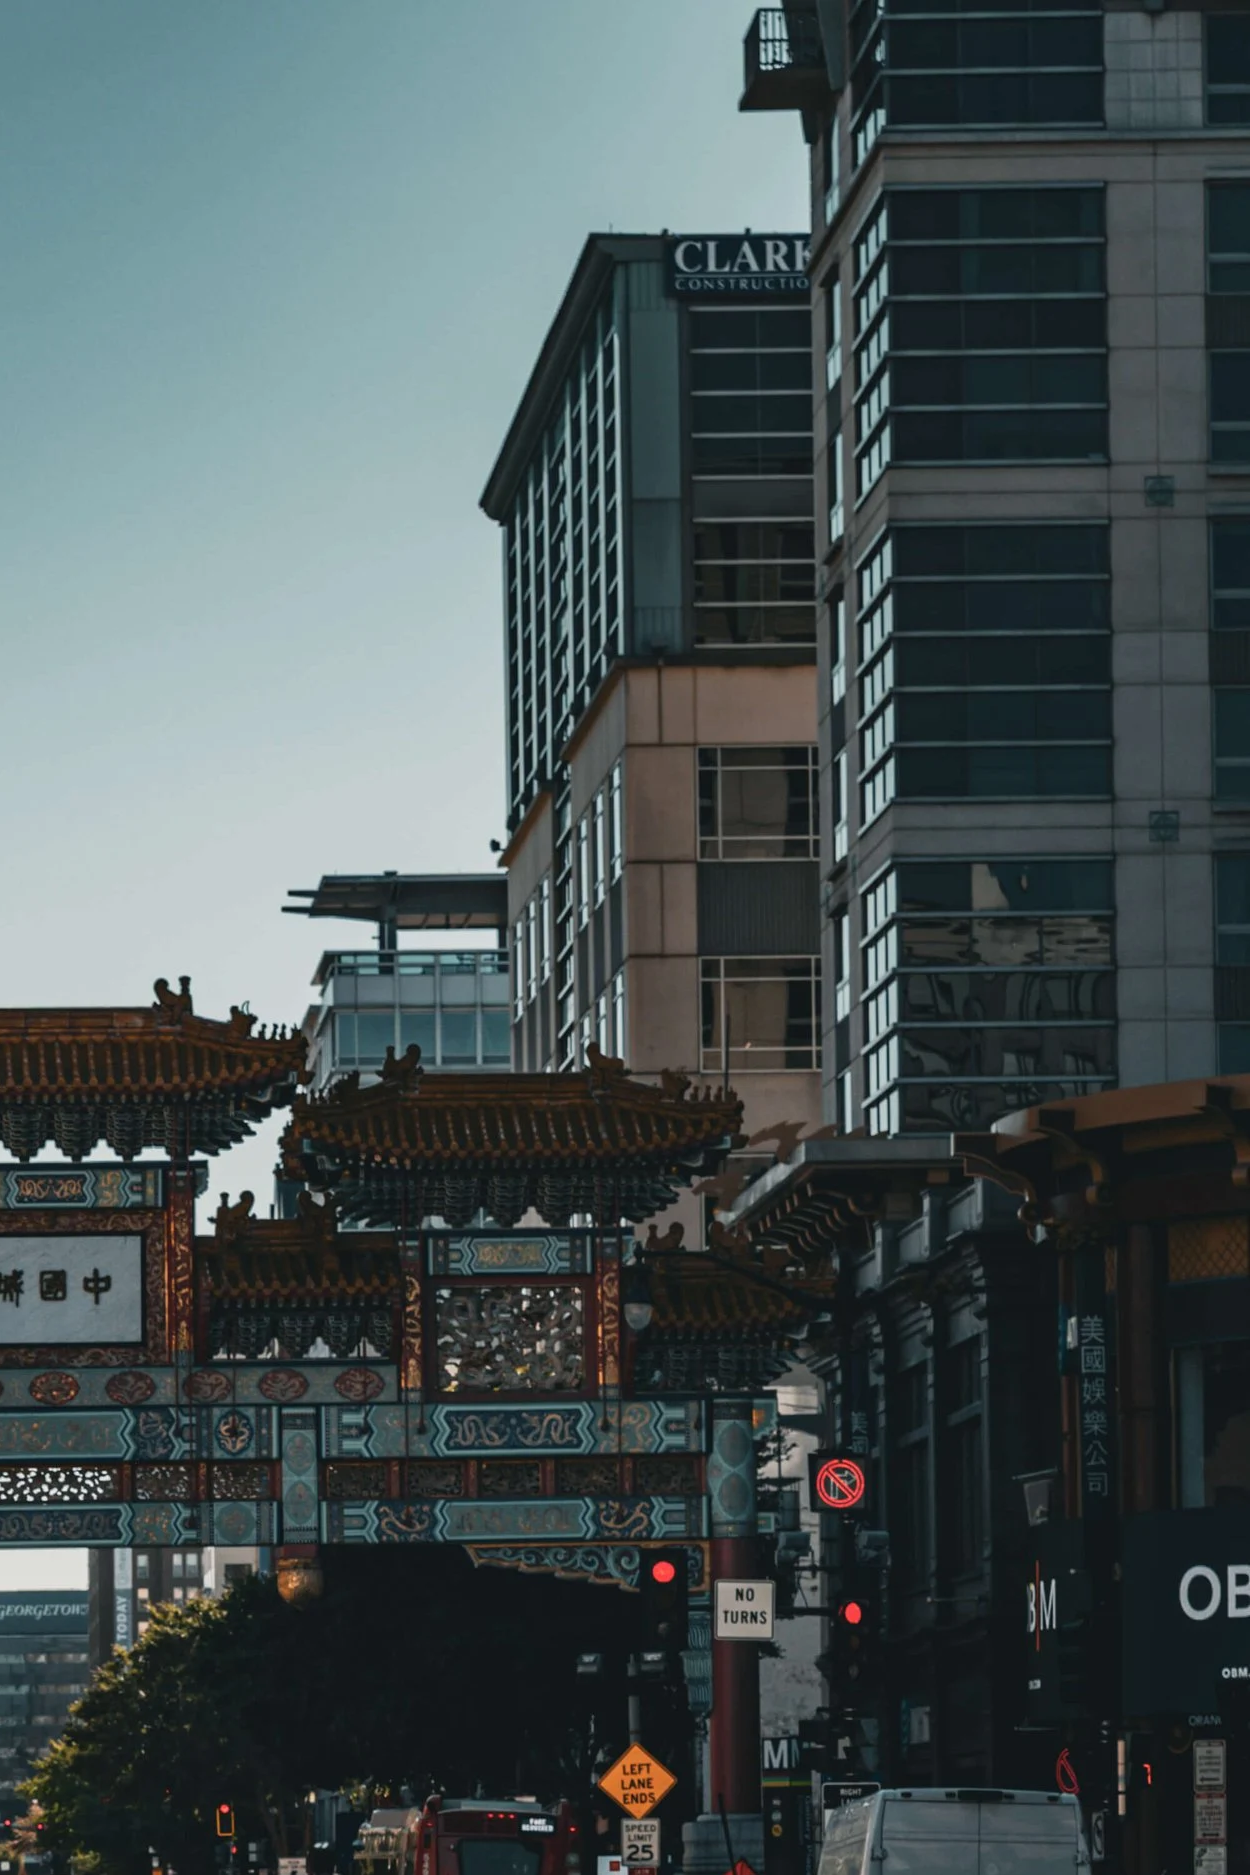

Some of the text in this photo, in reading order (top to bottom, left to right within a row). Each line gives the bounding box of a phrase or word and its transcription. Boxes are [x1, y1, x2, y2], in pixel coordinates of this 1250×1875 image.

[674, 240, 811, 272] CLARK
[1079, 1315, 1108, 1497] 美國娛樂公司
[735, 1587, 755, 1602] NO
[1179, 1565, 1250, 1621] OB
[116, 1596, 128, 1641] TODAY
[723, 1610, 767, 1625] TURNS
[622, 1763, 652, 1776] LEFT
[621, 1778, 654, 1790] LANE
[623, 1792, 656, 1805] ENDS
[625, 1824, 657, 1833] SPEED
[628, 1834, 653, 1842] LIMIT
[627, 1845, 654, 1861] 25
